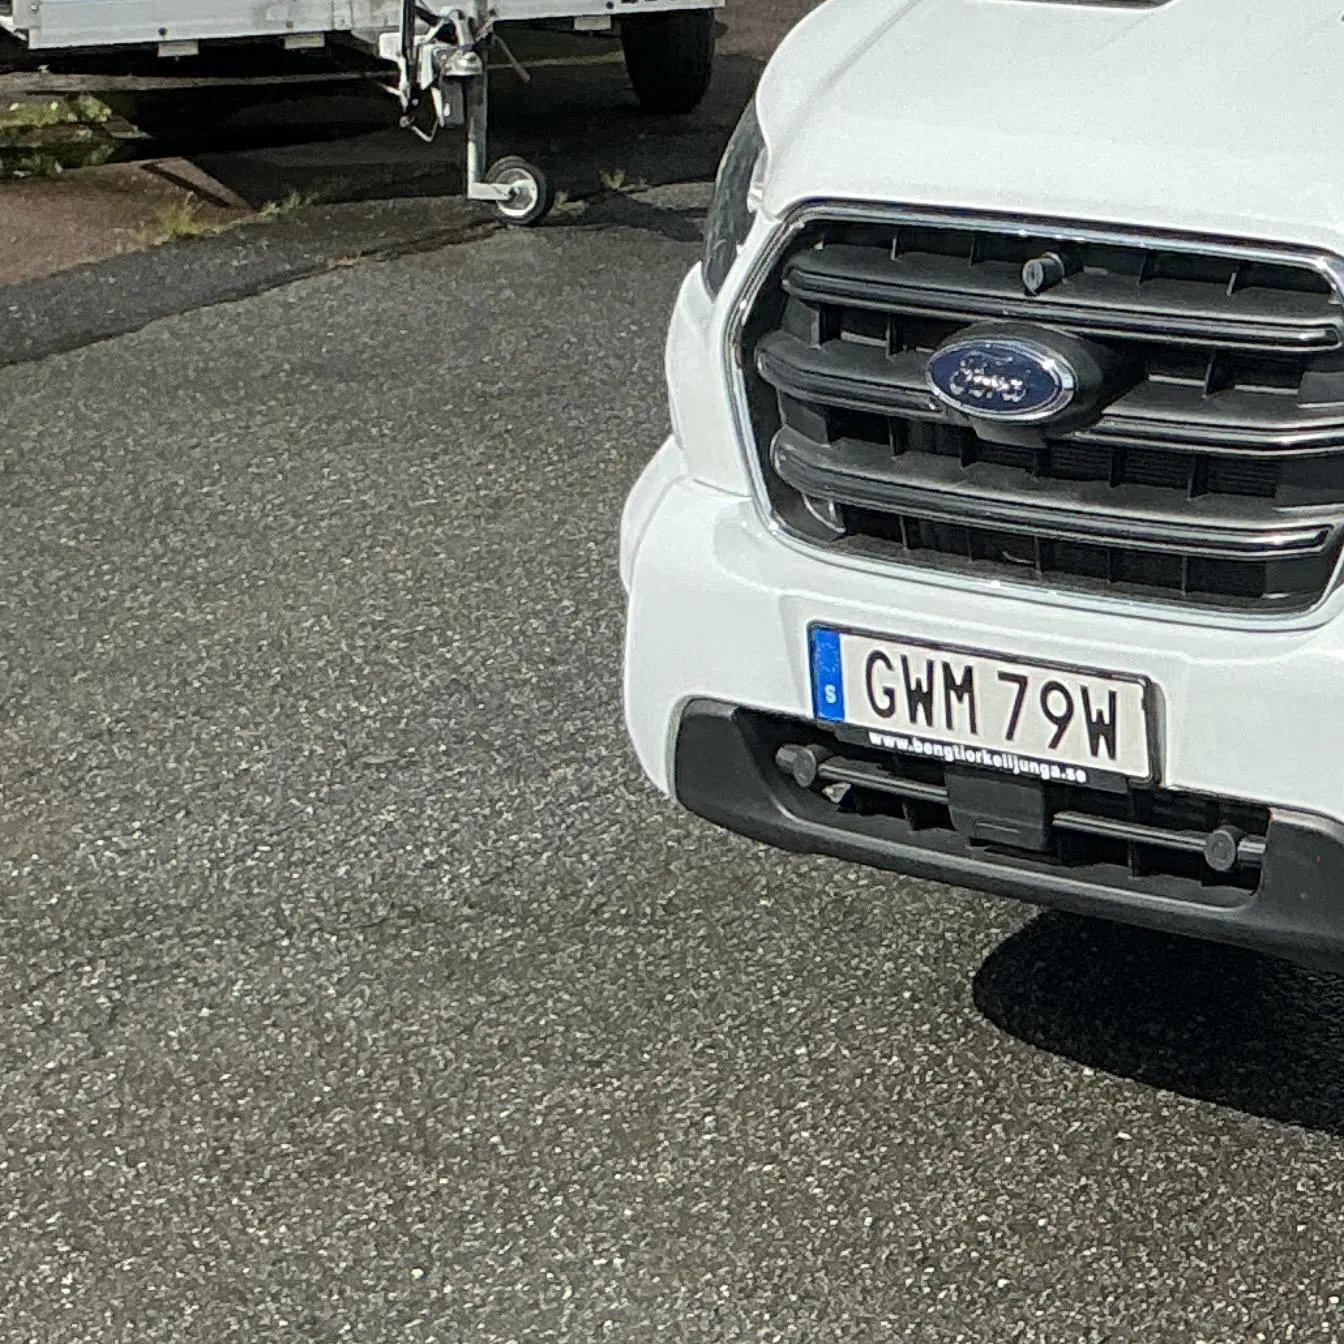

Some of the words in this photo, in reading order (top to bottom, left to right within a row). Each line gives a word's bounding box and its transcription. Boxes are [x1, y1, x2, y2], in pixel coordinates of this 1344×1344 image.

[824, 683, 837, 705] S
[865, 649, 978, 736] GWM
[997, 669, 1118, 761] 79W
